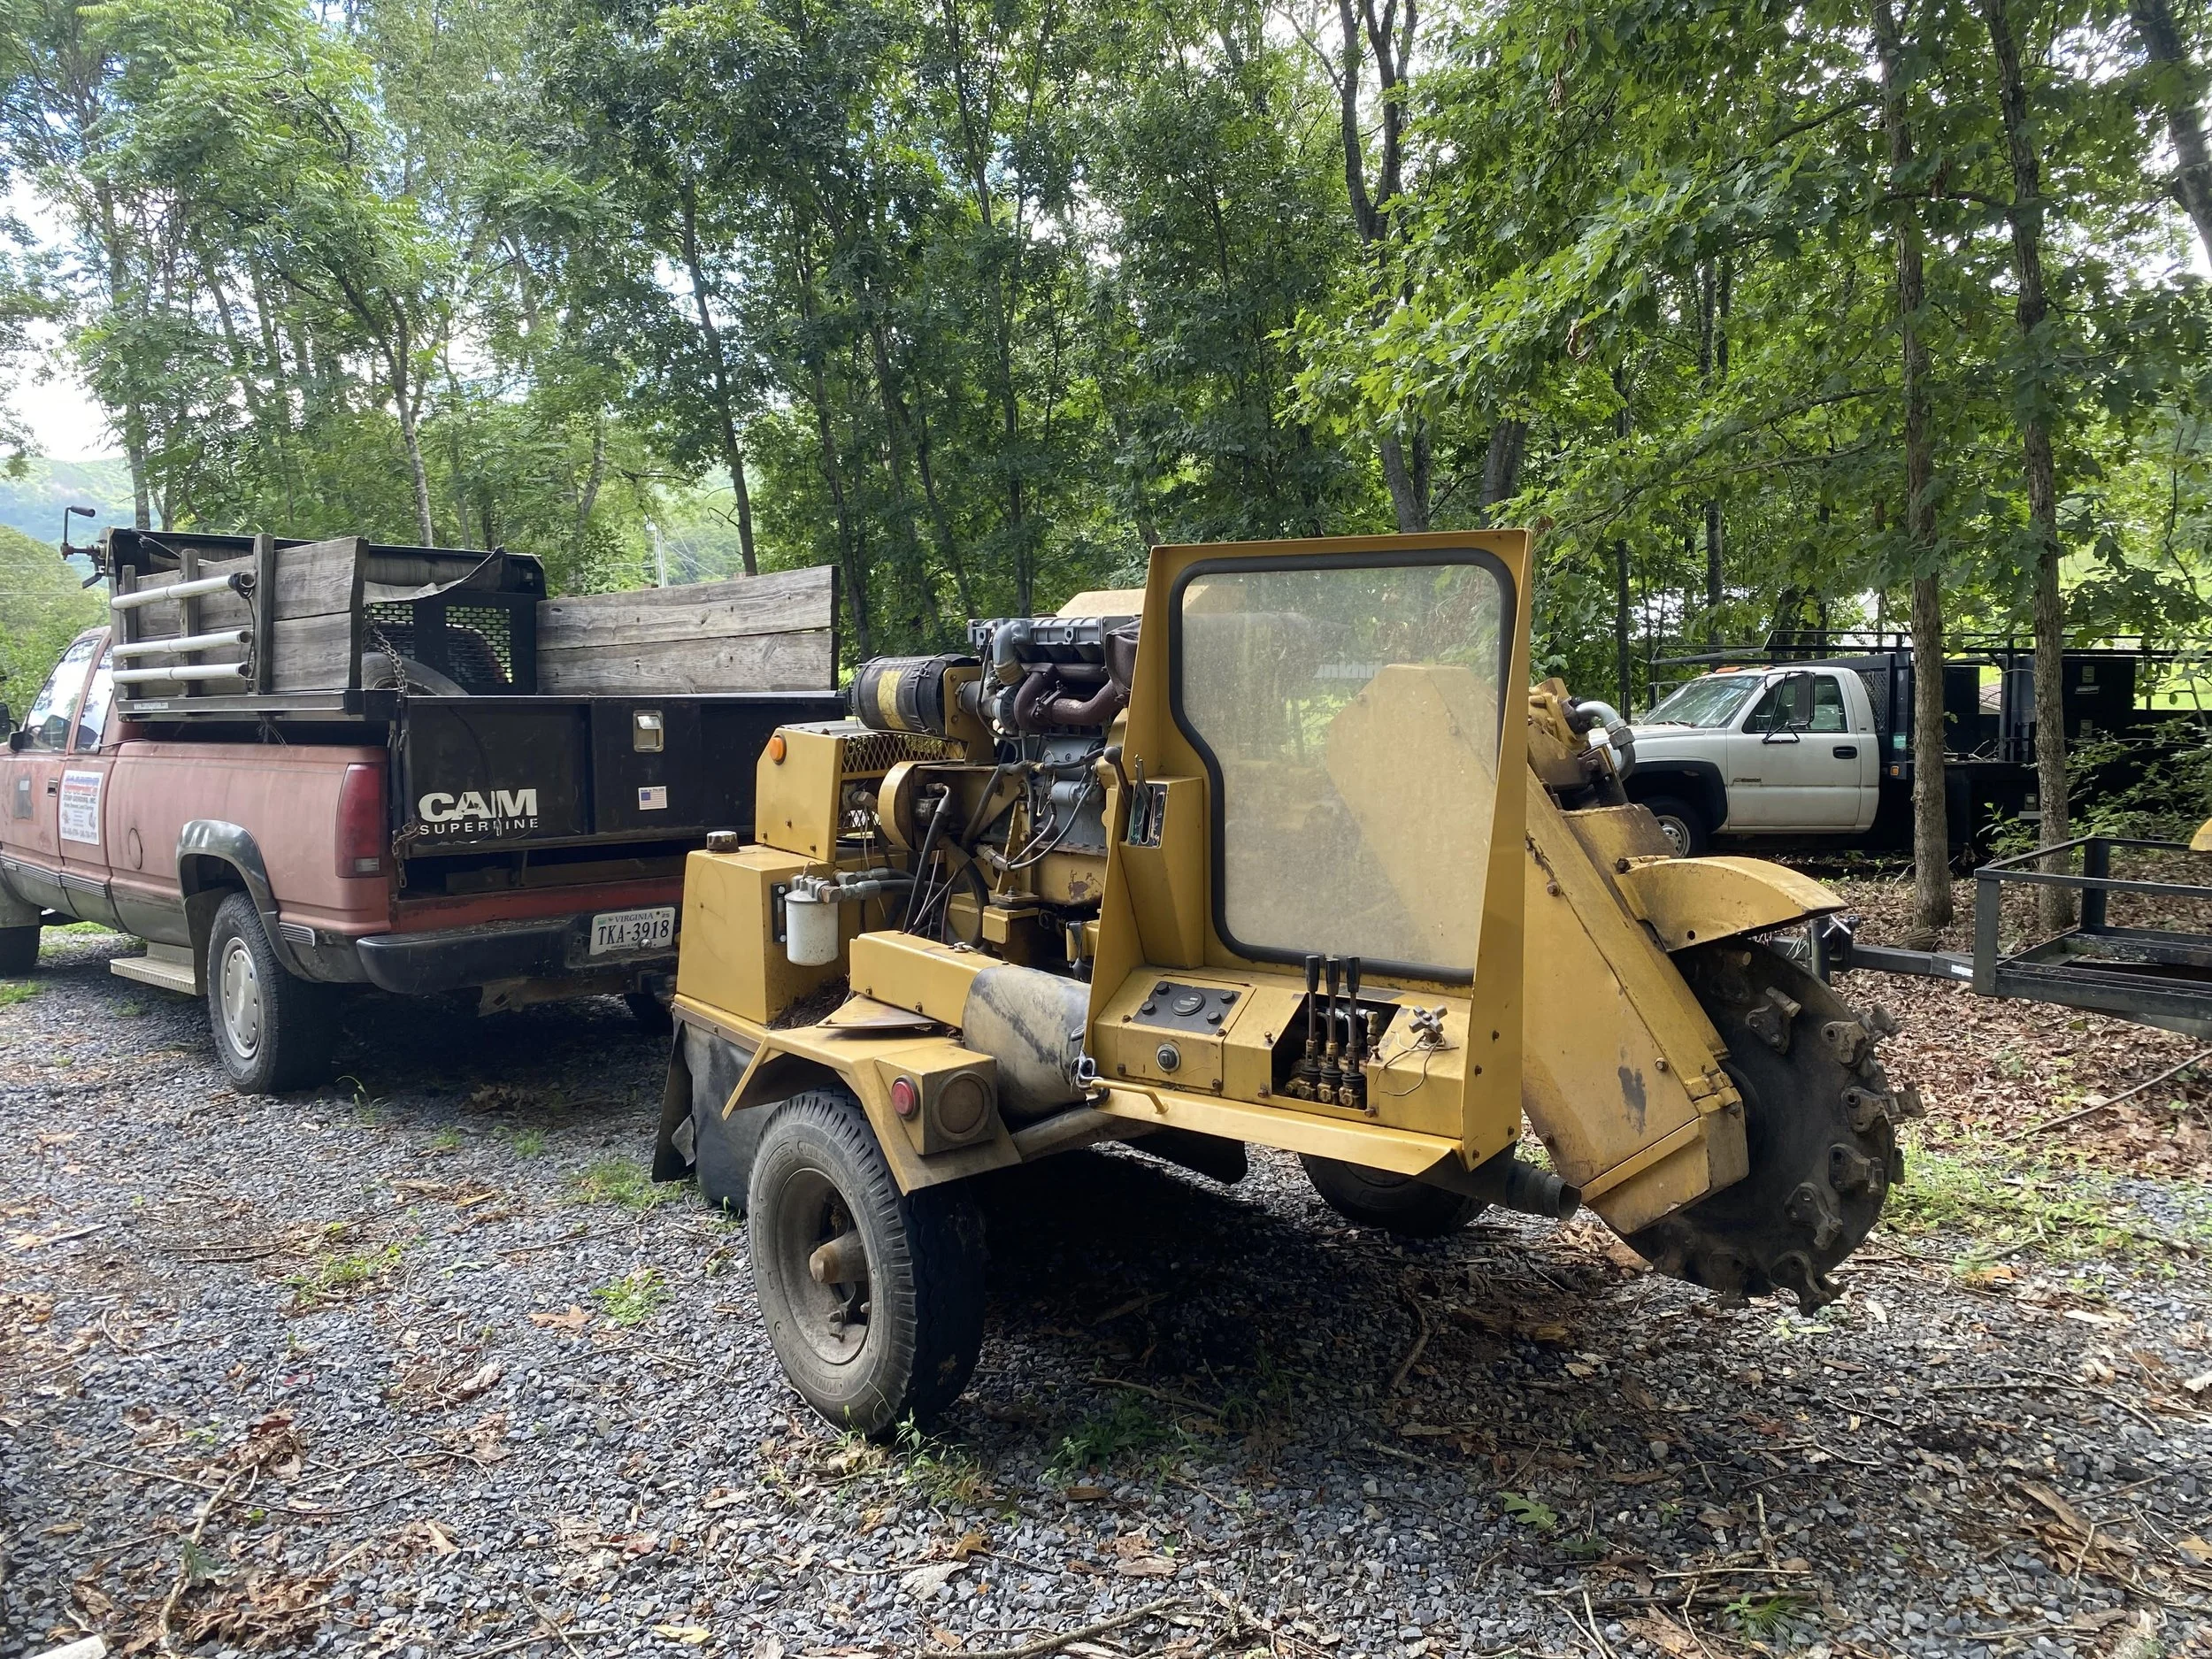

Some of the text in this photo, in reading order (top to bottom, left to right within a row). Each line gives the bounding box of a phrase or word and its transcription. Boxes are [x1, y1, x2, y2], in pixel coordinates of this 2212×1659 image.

[419, 788, 538, 822] CAM
[615, 912, 654, 923] VIRGINIA
[598, 919, 670, 946] TKA-3918
